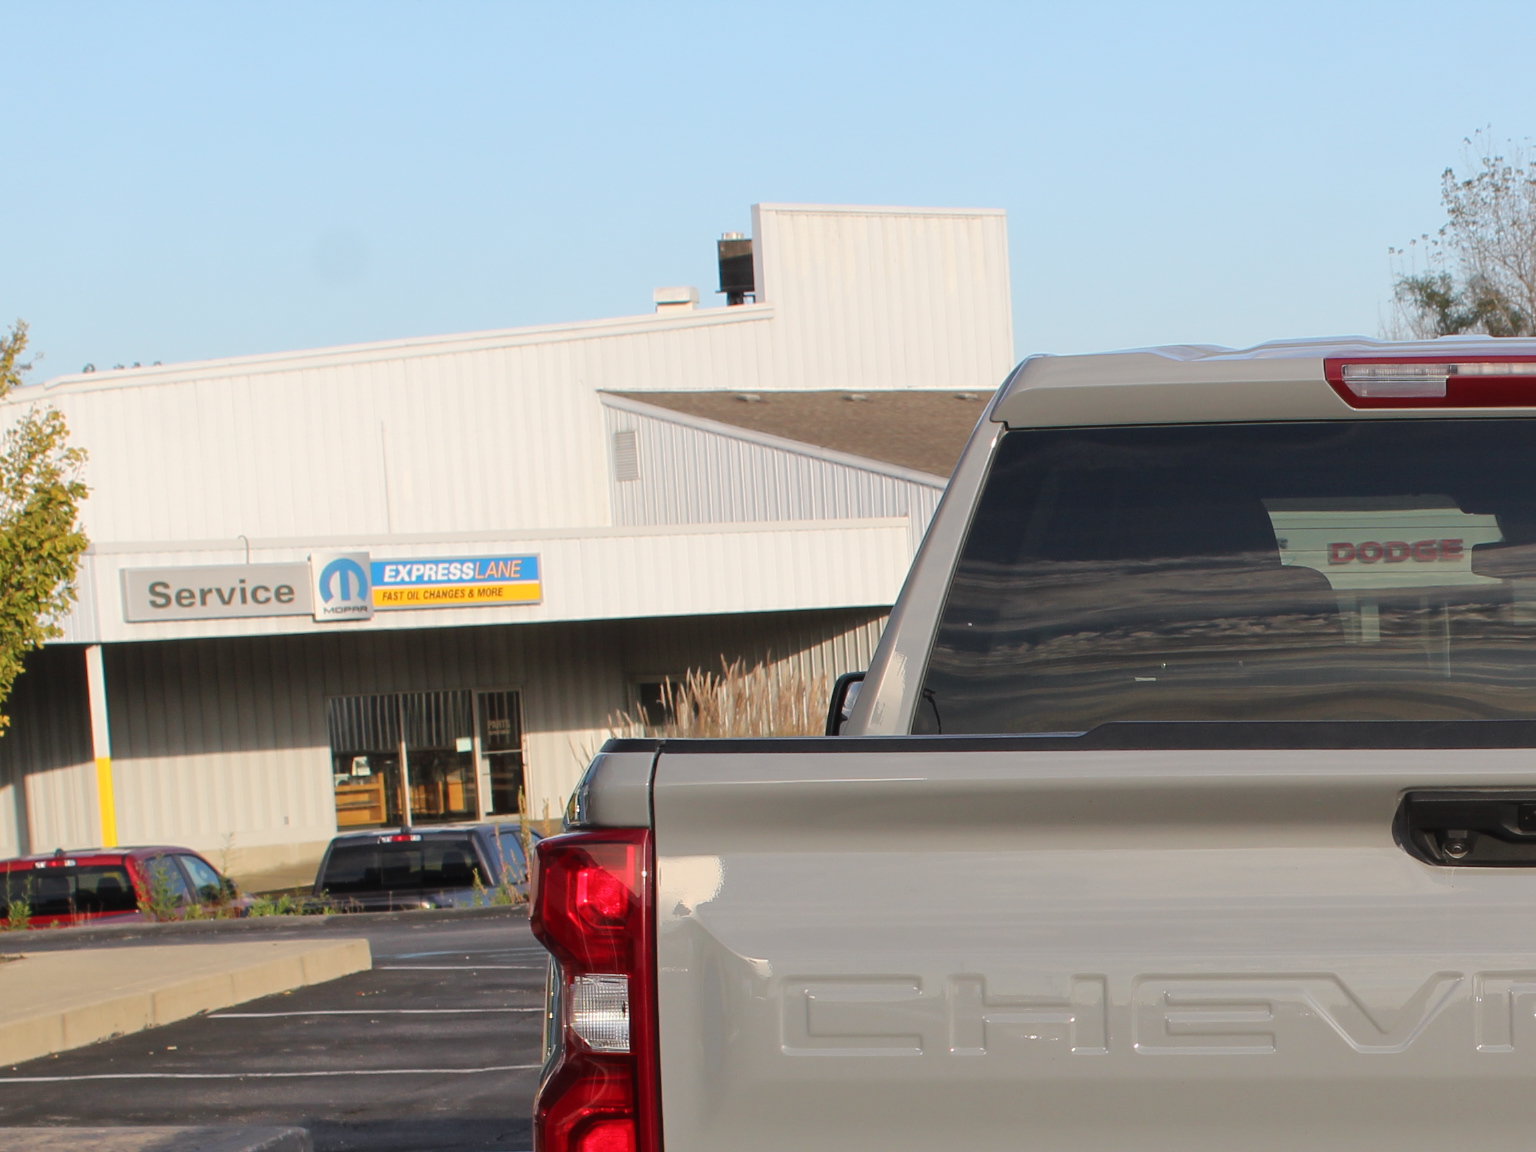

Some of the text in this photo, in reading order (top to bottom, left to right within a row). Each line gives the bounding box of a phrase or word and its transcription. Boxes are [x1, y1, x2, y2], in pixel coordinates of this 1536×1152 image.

[1327, 538, 1464, 566] DODGE
[383, 560, 523, 582] EXPRESSLANE
[148, 578, 296, 609] Service
[382, 587, 504, 601] FAST OIL CHANGES & MORE
[323, 605, 368, 615] MOPAR
